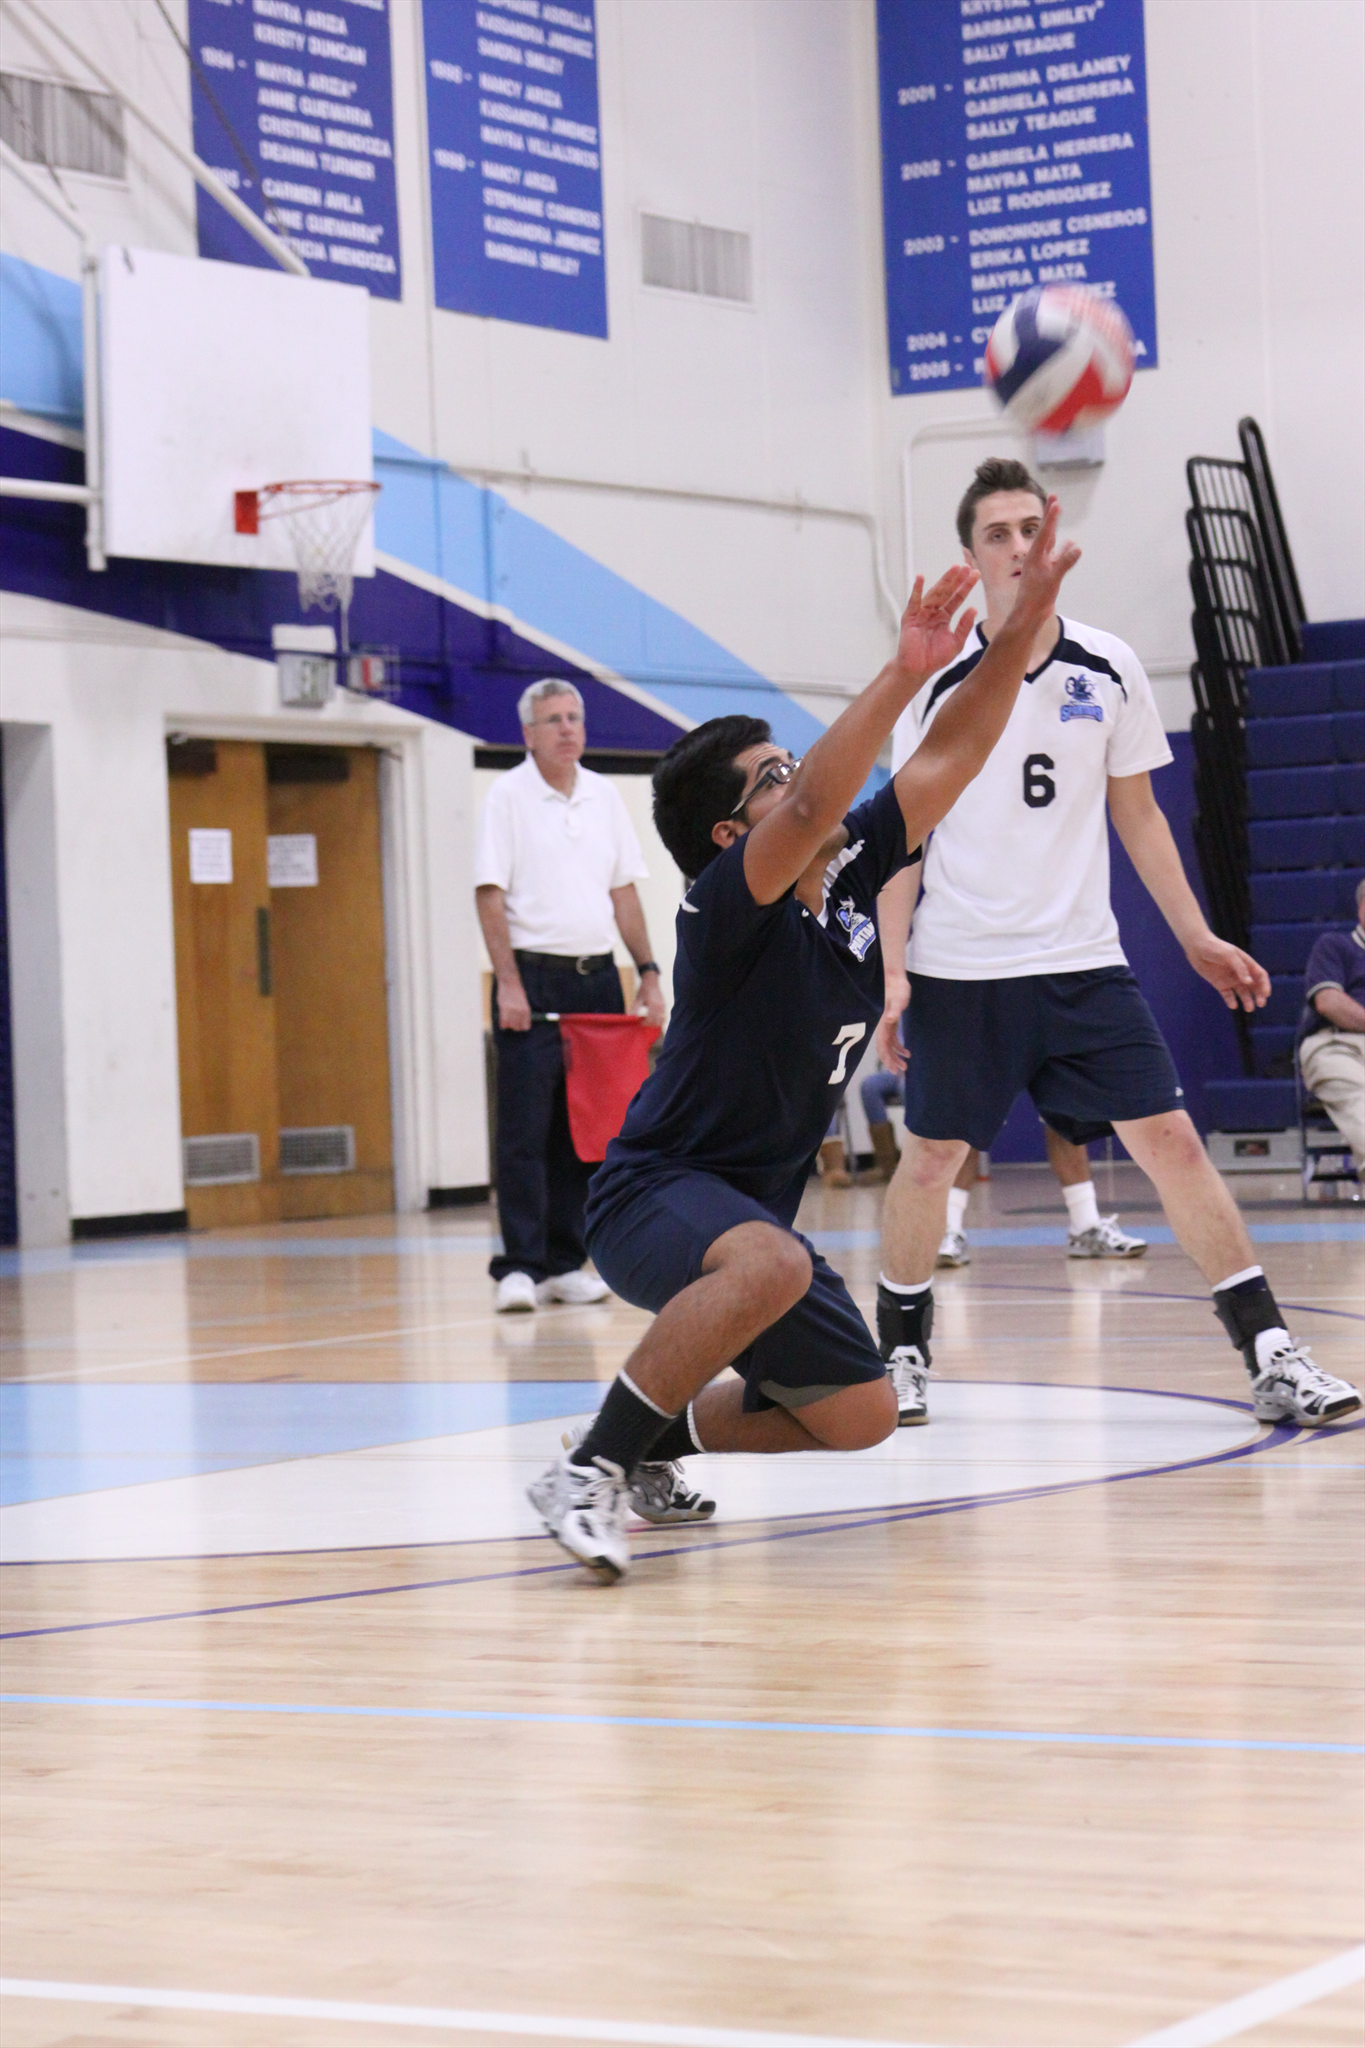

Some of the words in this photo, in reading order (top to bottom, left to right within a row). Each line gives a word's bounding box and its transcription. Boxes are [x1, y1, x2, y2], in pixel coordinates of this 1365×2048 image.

[962, 14, 1035, 41] BARBARA
[253, 22, 306, 51] KRISTY
[307, 35, 367, 66] DUNCAN
[963, 43, 1009, 65] SALLY
[1013, 32, 1075, 56] TEAGUE
[479, 72, 523, 98] NANCY
[898, 84, 936, 105] 2001
[964, 68, 1041, 94] KATRINA
[1046, 54, 1131, 82] DELANEY
[257, 87, 298, 113] ANNE
[965, 91, 1049, 117] GABRIELA
[1053, 78, 1135, 104] HERRERA
[258, 113, 324, 144] CRISTINA
[966, 118, 1019, 140] SALLY
[1024, 106, 1096, 131] TEAGUE
[319, 152, 376, 182] TURNER
[481, 160, 522, 185] NANCY
[901, 159, 941, 181] 2002
[966, 144, 1049, 171] GABRIELA
[1053, 132, 1135, 159] HERRERA
[261, 177, 323, 207] CARMEN
[967, 169, 1029, 193] MAYRA
[1034, 162, 1083, 184] MATA
[967, 197, 1001, 216] LUZ
[1007, 181, 1111, 211] RODRIGUEZ
[904, 235, 945, 256] 2003
[969, 218, 1062, 246] DOMONIQUE
[1066, 206, 1148, 234] CISNEROS
[970, 247, 1026, 270] ERIKA
[1031, 238, 1090, 261] LOPEZ
[971, 269, 1034, 292] MAYRA
[1039, 262, 1088, 283] MATA
[907, 331, 948, 352] 2004
[1023, 753, 1056, 808] 6
[828, 1022, 866, 1085] 7
